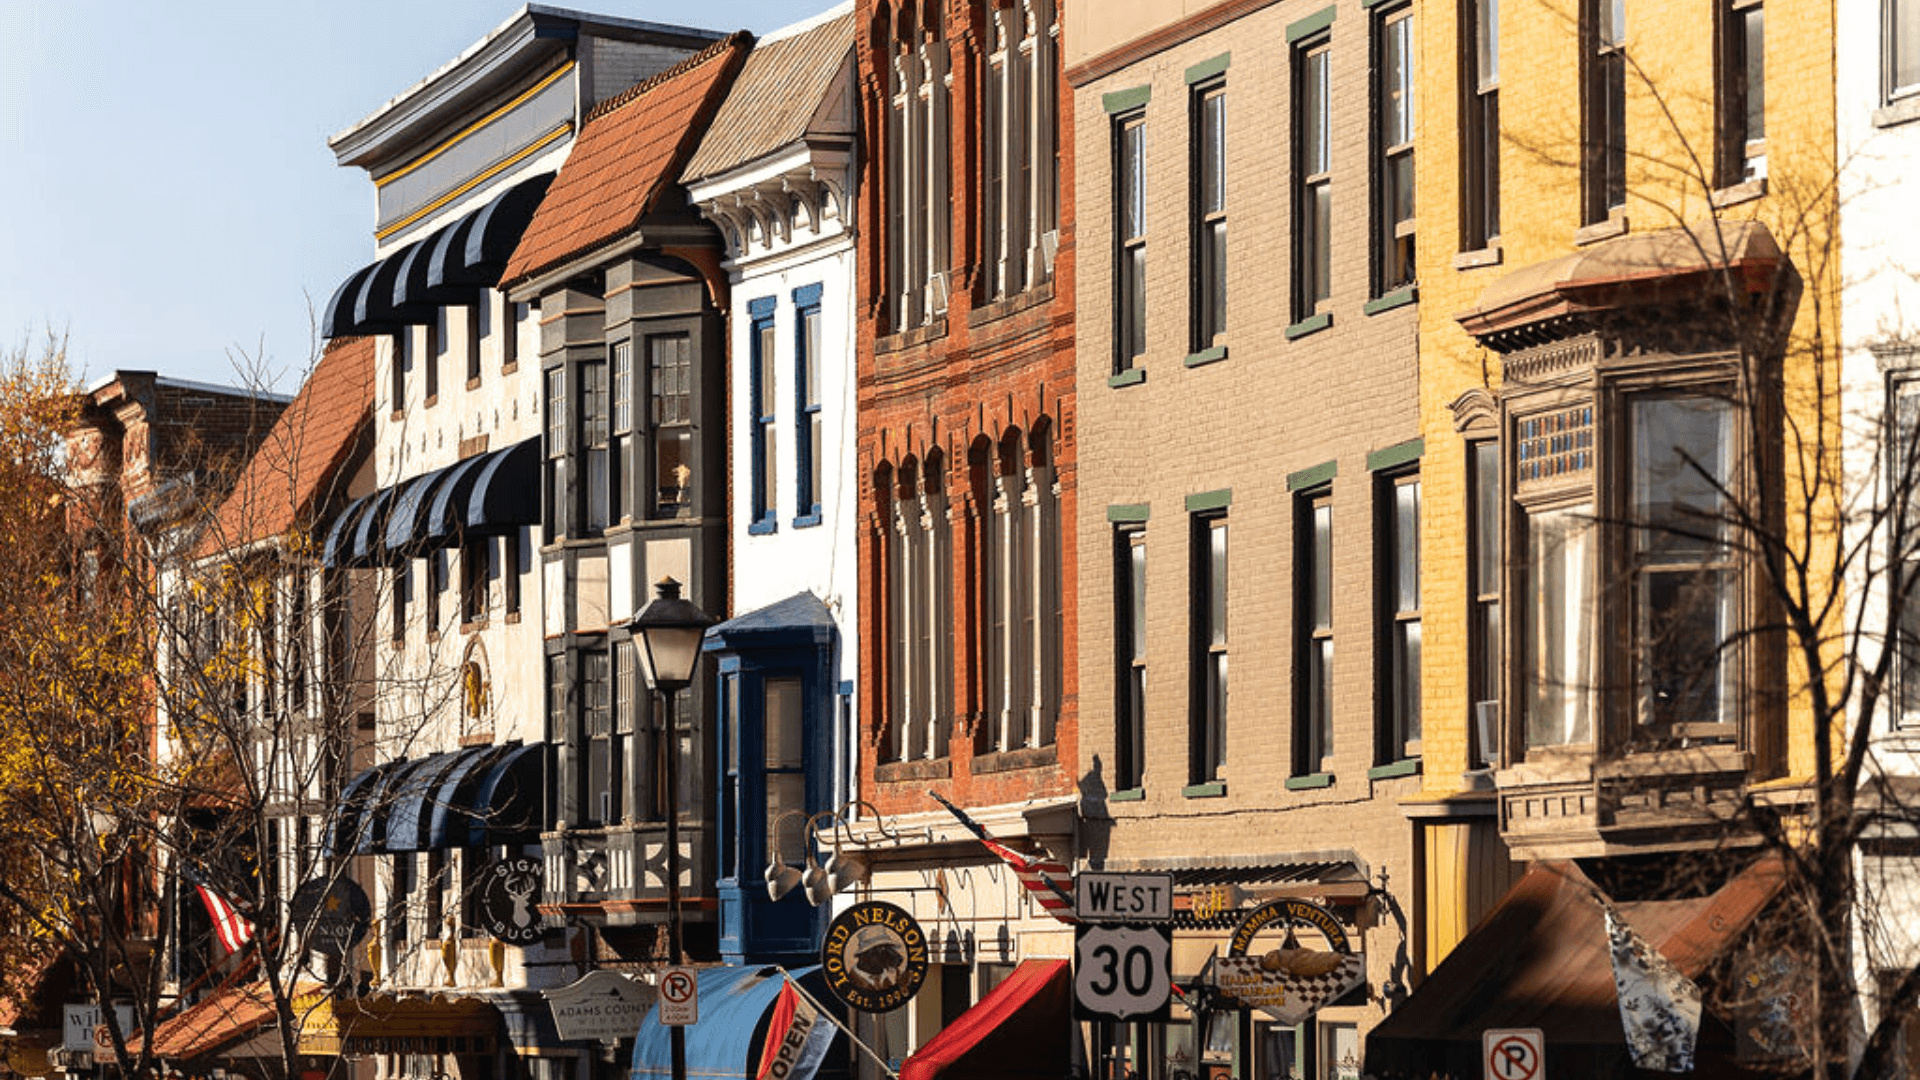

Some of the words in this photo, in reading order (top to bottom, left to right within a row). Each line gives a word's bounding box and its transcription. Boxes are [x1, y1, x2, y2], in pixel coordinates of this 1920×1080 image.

[496, 859, 543, 877] SIGN
[1089, 882, 1161, 913] WEST
[494, 921, 547, 939] BUCK
[1234, 906, 1278, 951] MAMMA
[1287, 904, 1344, 946] VENTURA
[827, 925, 849, 988] LORD
[1090, 944, 1153, 996] 30
[559, 1005, 601, 1017] ADAMS
[771, 1013, 811, 1079] OPEN
